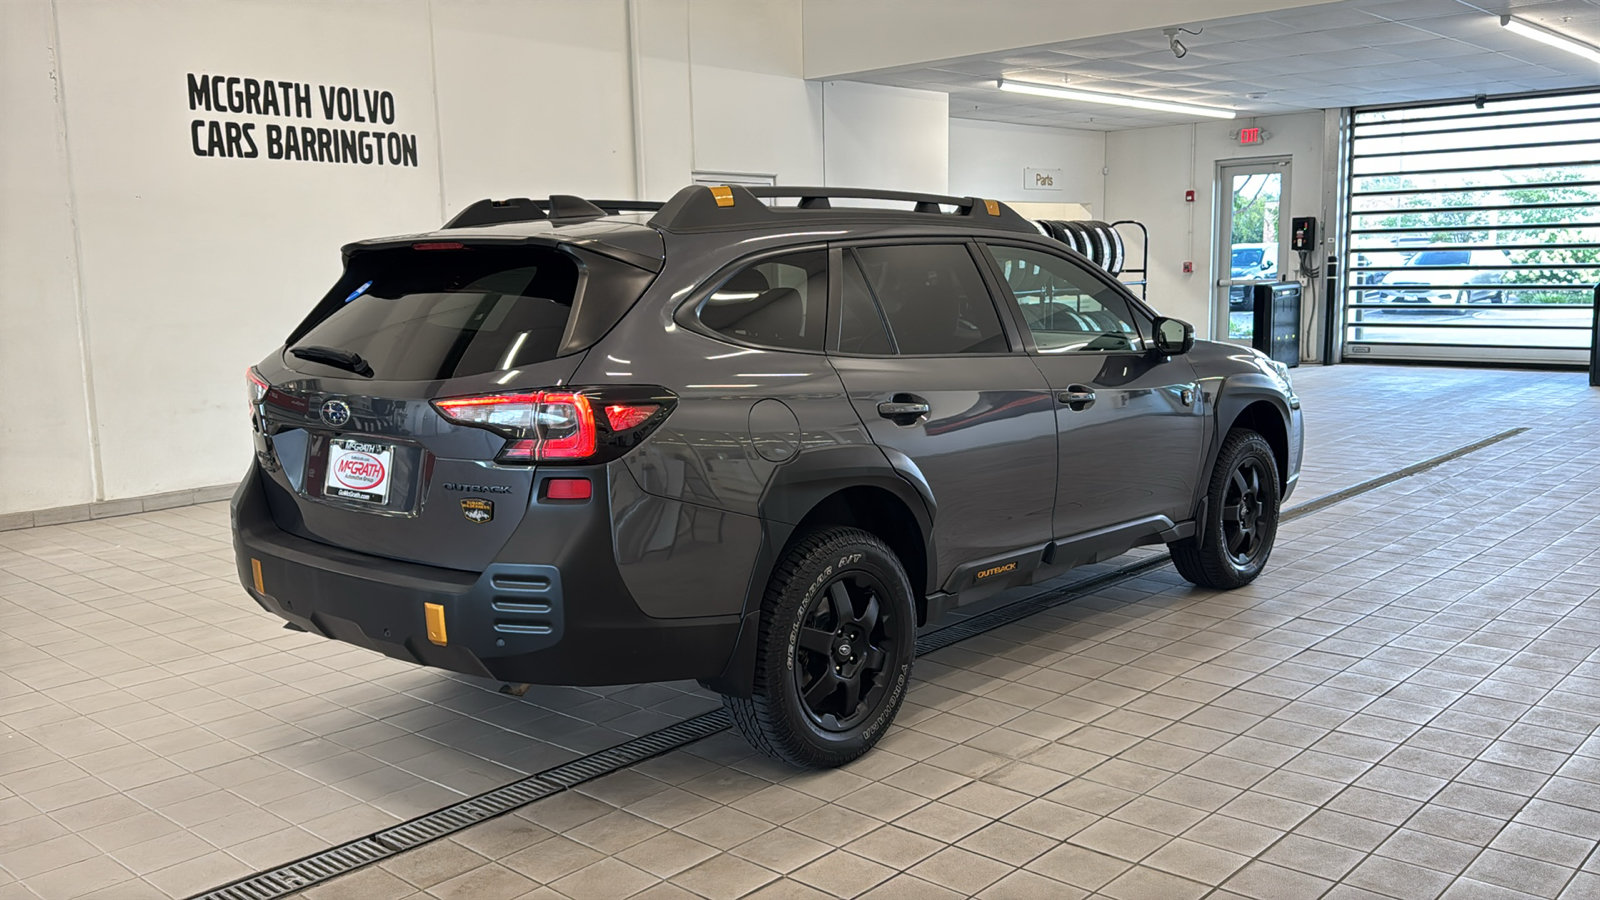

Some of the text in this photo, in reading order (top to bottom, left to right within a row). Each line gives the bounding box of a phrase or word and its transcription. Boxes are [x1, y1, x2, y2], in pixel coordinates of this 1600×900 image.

[187, 73, 395, 125] MCGRATH VOLVO
[191, 119, 418, 167] CARS BARRINGTON
[1241, 128, 1258, 143] EXIT
[1036, 173, 1053, 186] Parts
[442, 482, 512, 494] OUTBACK
[977, 562, 1017, 579] OUTBACK
[862, 663, 908, 740] YOKOHAMA
